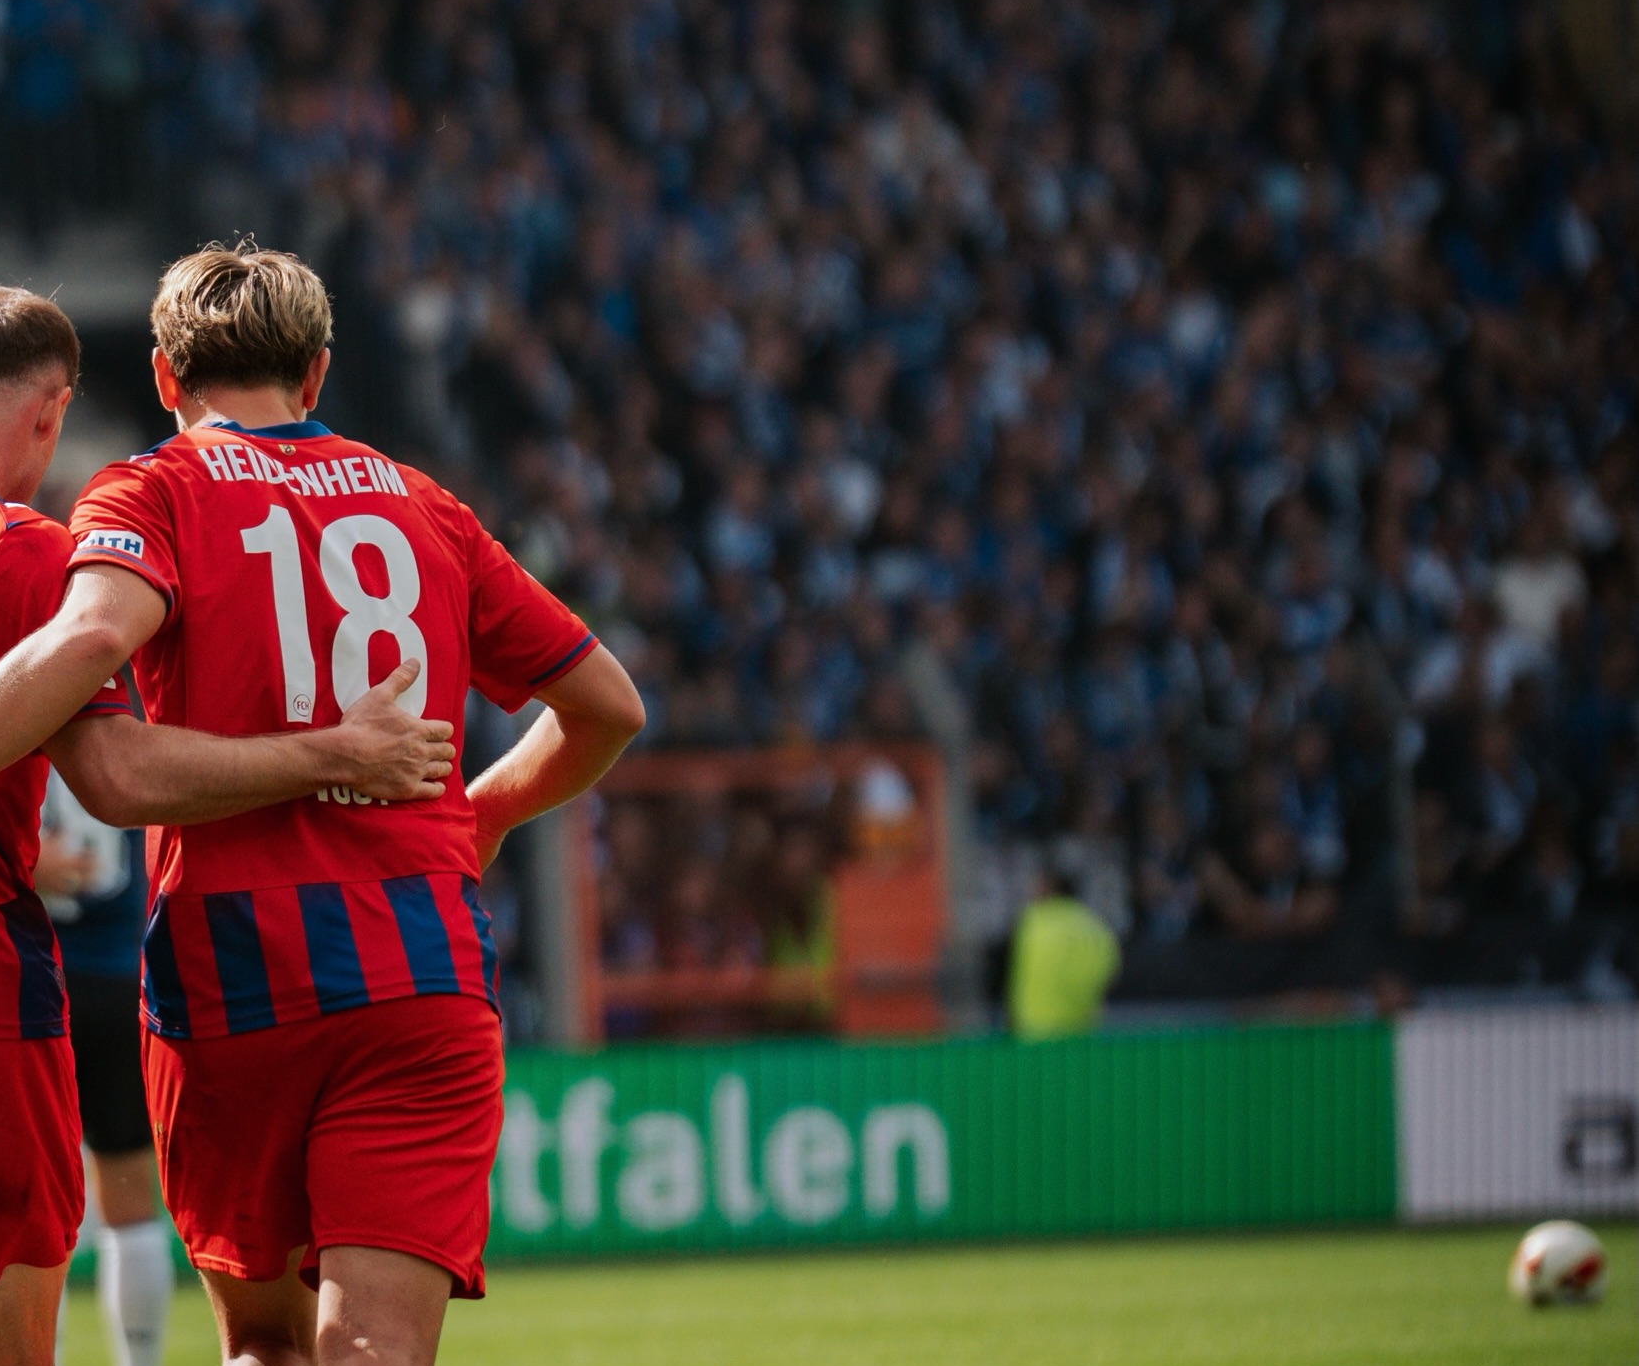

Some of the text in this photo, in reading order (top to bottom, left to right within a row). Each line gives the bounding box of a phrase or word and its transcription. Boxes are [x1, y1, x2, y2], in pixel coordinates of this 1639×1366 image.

[198, 444, 408, 497] HEIDENHEIM
[83, 536, 142, 555] ITH
[240, 504, 429, 724] 18
[492, 1072, 951, 1232] tfalen
